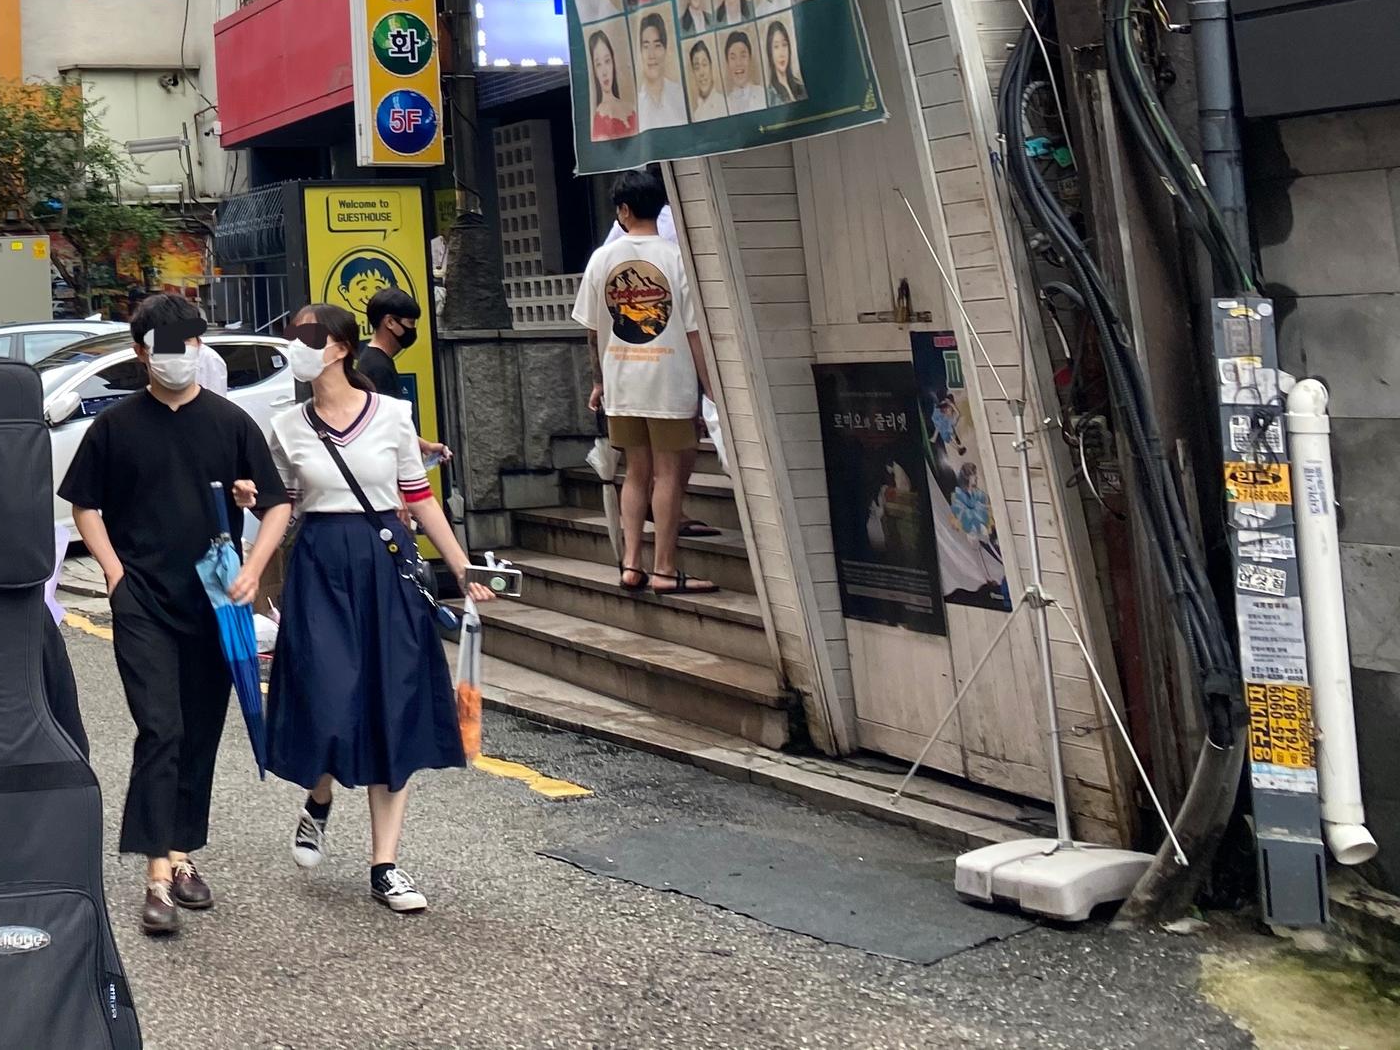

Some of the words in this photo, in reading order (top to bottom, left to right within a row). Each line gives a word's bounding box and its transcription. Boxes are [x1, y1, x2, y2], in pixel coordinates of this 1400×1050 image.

[389, 108, 423, 135] 5F
[338, 199, 377, 209] Welcome
[379, 198, 389, 209] to
[337, 212, 392, 222] GUESTHOUSE
